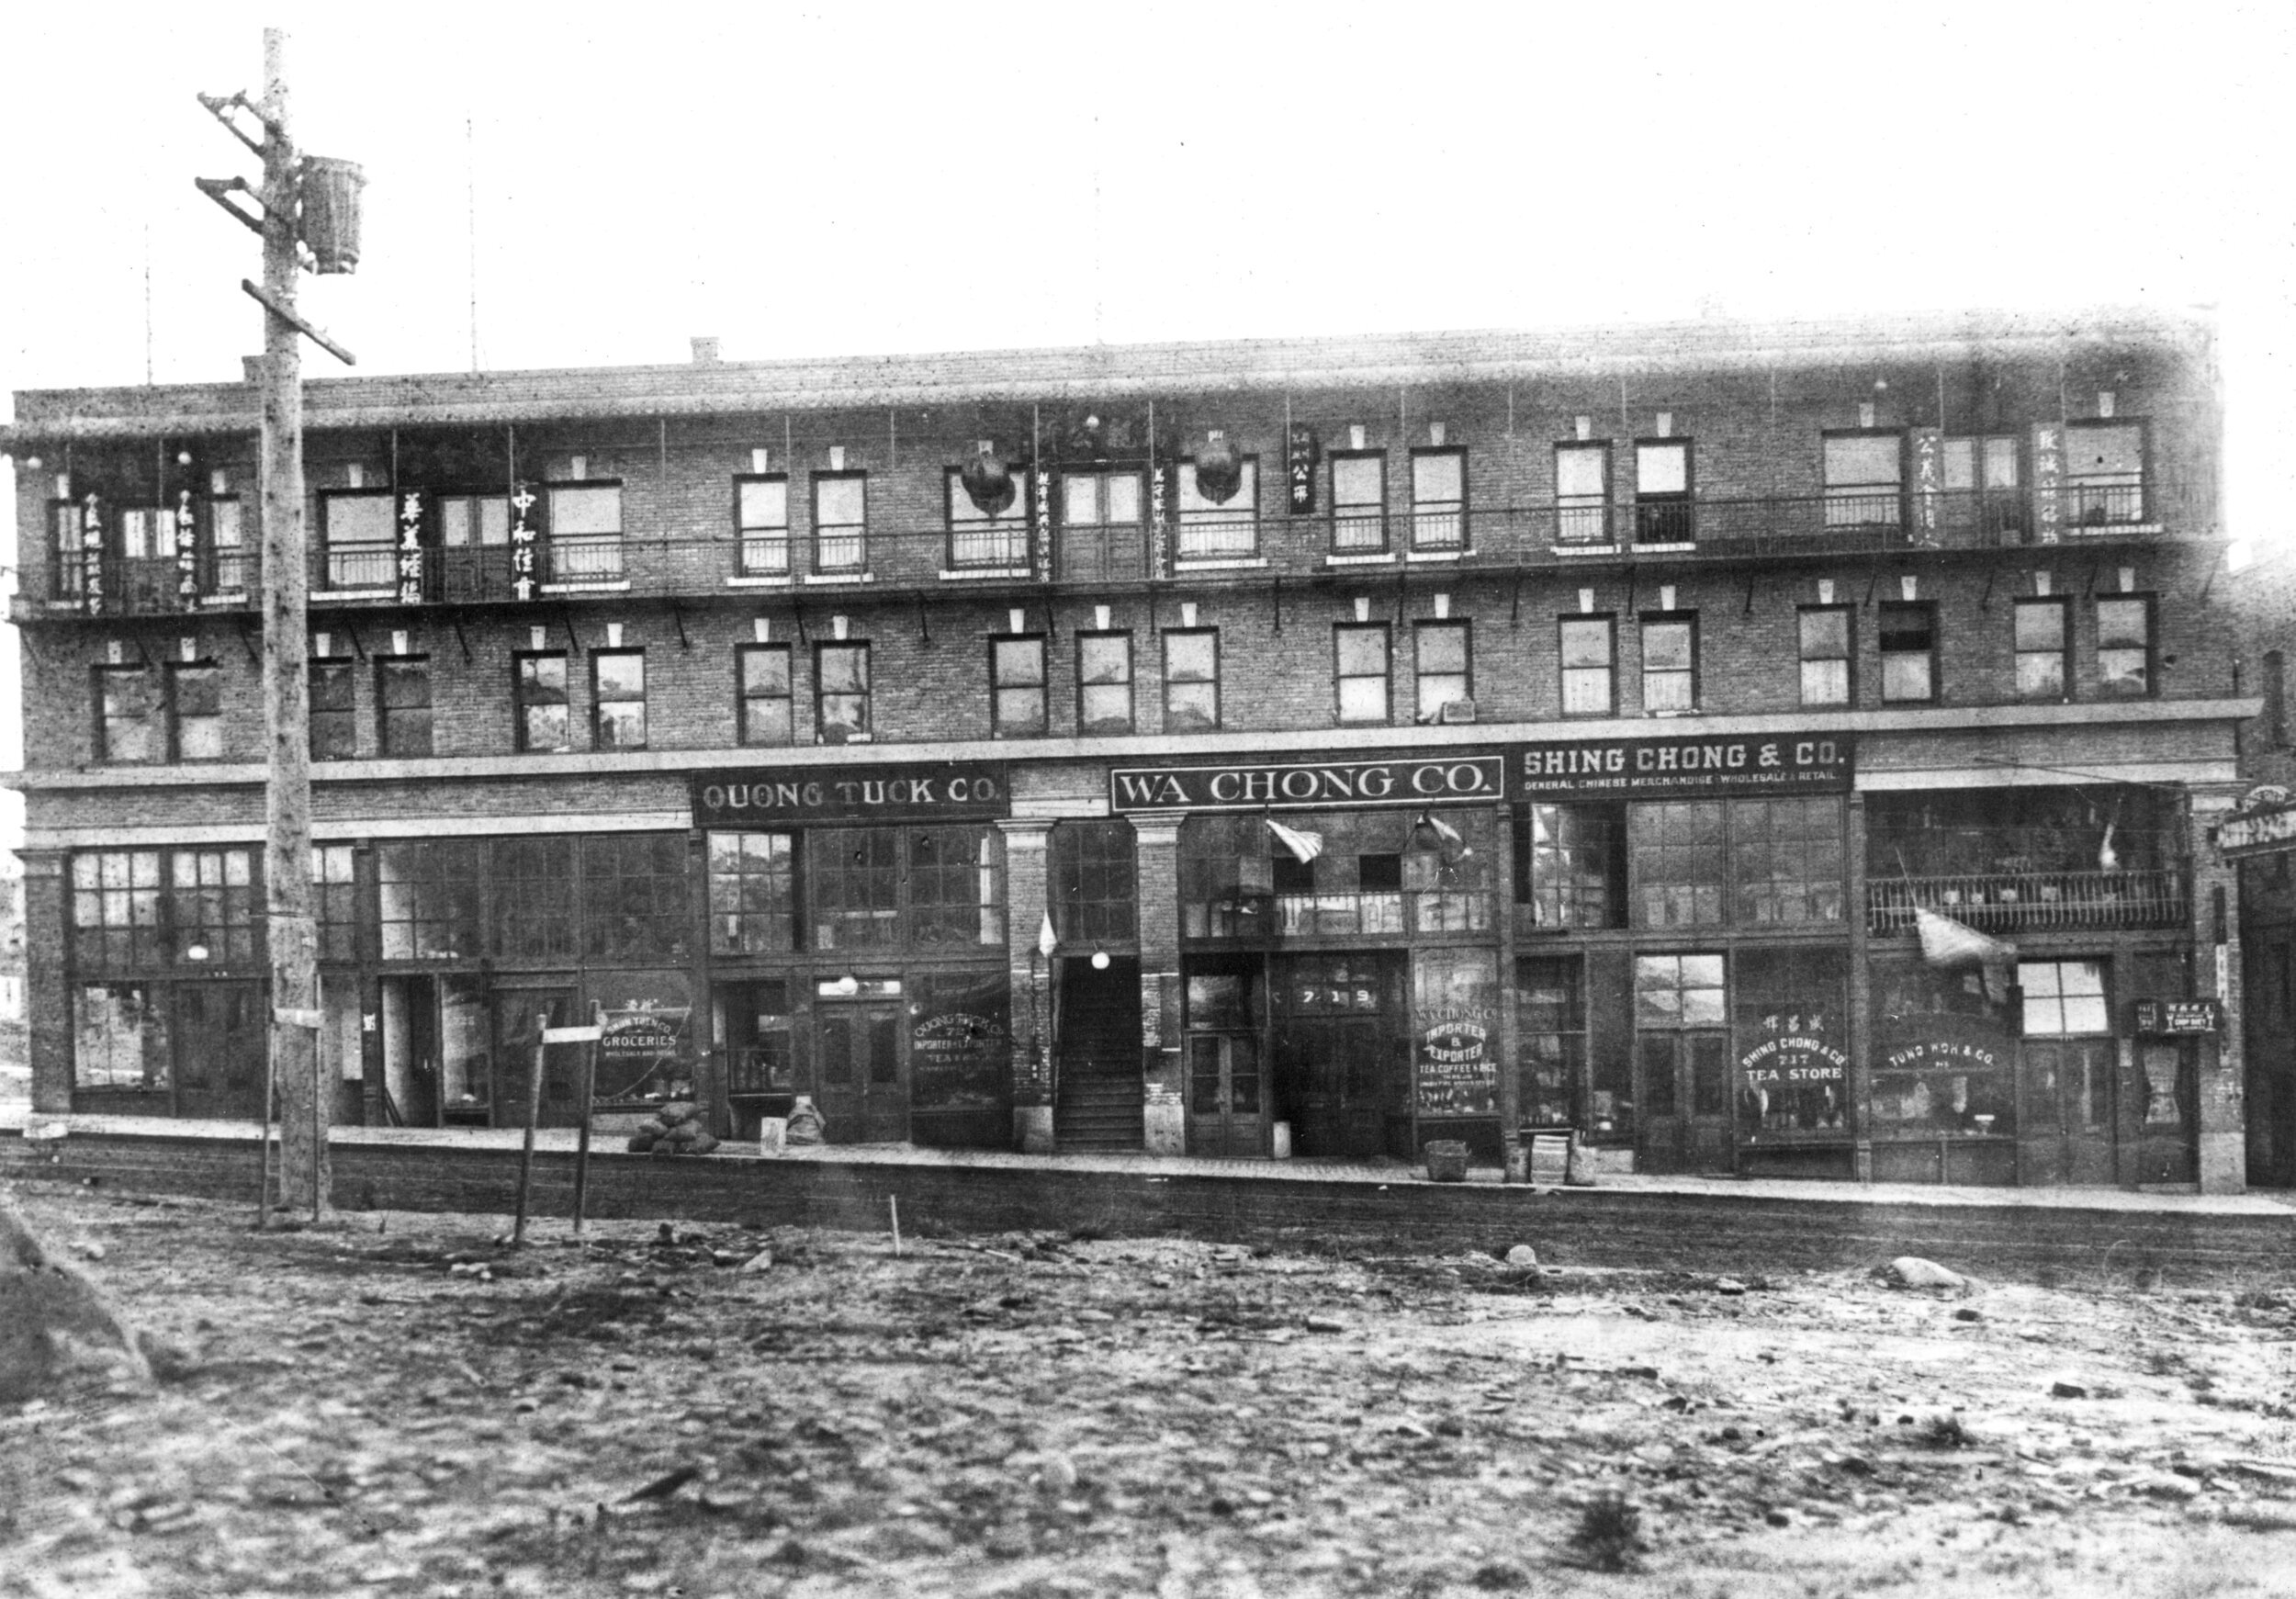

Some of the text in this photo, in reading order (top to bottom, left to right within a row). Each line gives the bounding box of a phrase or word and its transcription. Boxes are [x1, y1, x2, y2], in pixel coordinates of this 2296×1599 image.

[1525, 741, 1844, 774] SHING CHONG & CO.
[1120, 764, 1492, 803] WA CHONG CO.
[1525, 780, 1574, 791] GENERAL
[1579, 778, 1626, 789] CHINESE
[1631, 774, 1713, 786] MERCHANDISE
[1721, 772, 1786, 783] WHOLESALE
[1799, 771, 1836, 781] RETAIL
[703, 778, 1001, 812] QUONG TUCK CO.
[1437, 1008, 1481, 1019] CHONG
[602, 1035, 677, 1047] GROCERIES
[1426, 1022, 1486, 1044] IMPORTER
[1451, 1036, 1462, 1047] &
[1430, 1042, 1482, 1063] EXPORTER
[1742, 1041, 1777, 1067] SHING
[1780, 1037, 1819, 1052] CHONG
[1820, 1046, 1829, 1055] &
[1778, 1053, 1809, 1065] 717
[1889, 1045, 1923, 1067] TUNG
[1419, 1064, 1435, 1074] TEA
[1437, 1064, 1471, 1074] COFFEE
[1746, 1067, 1842, 1081] TEA STORE
